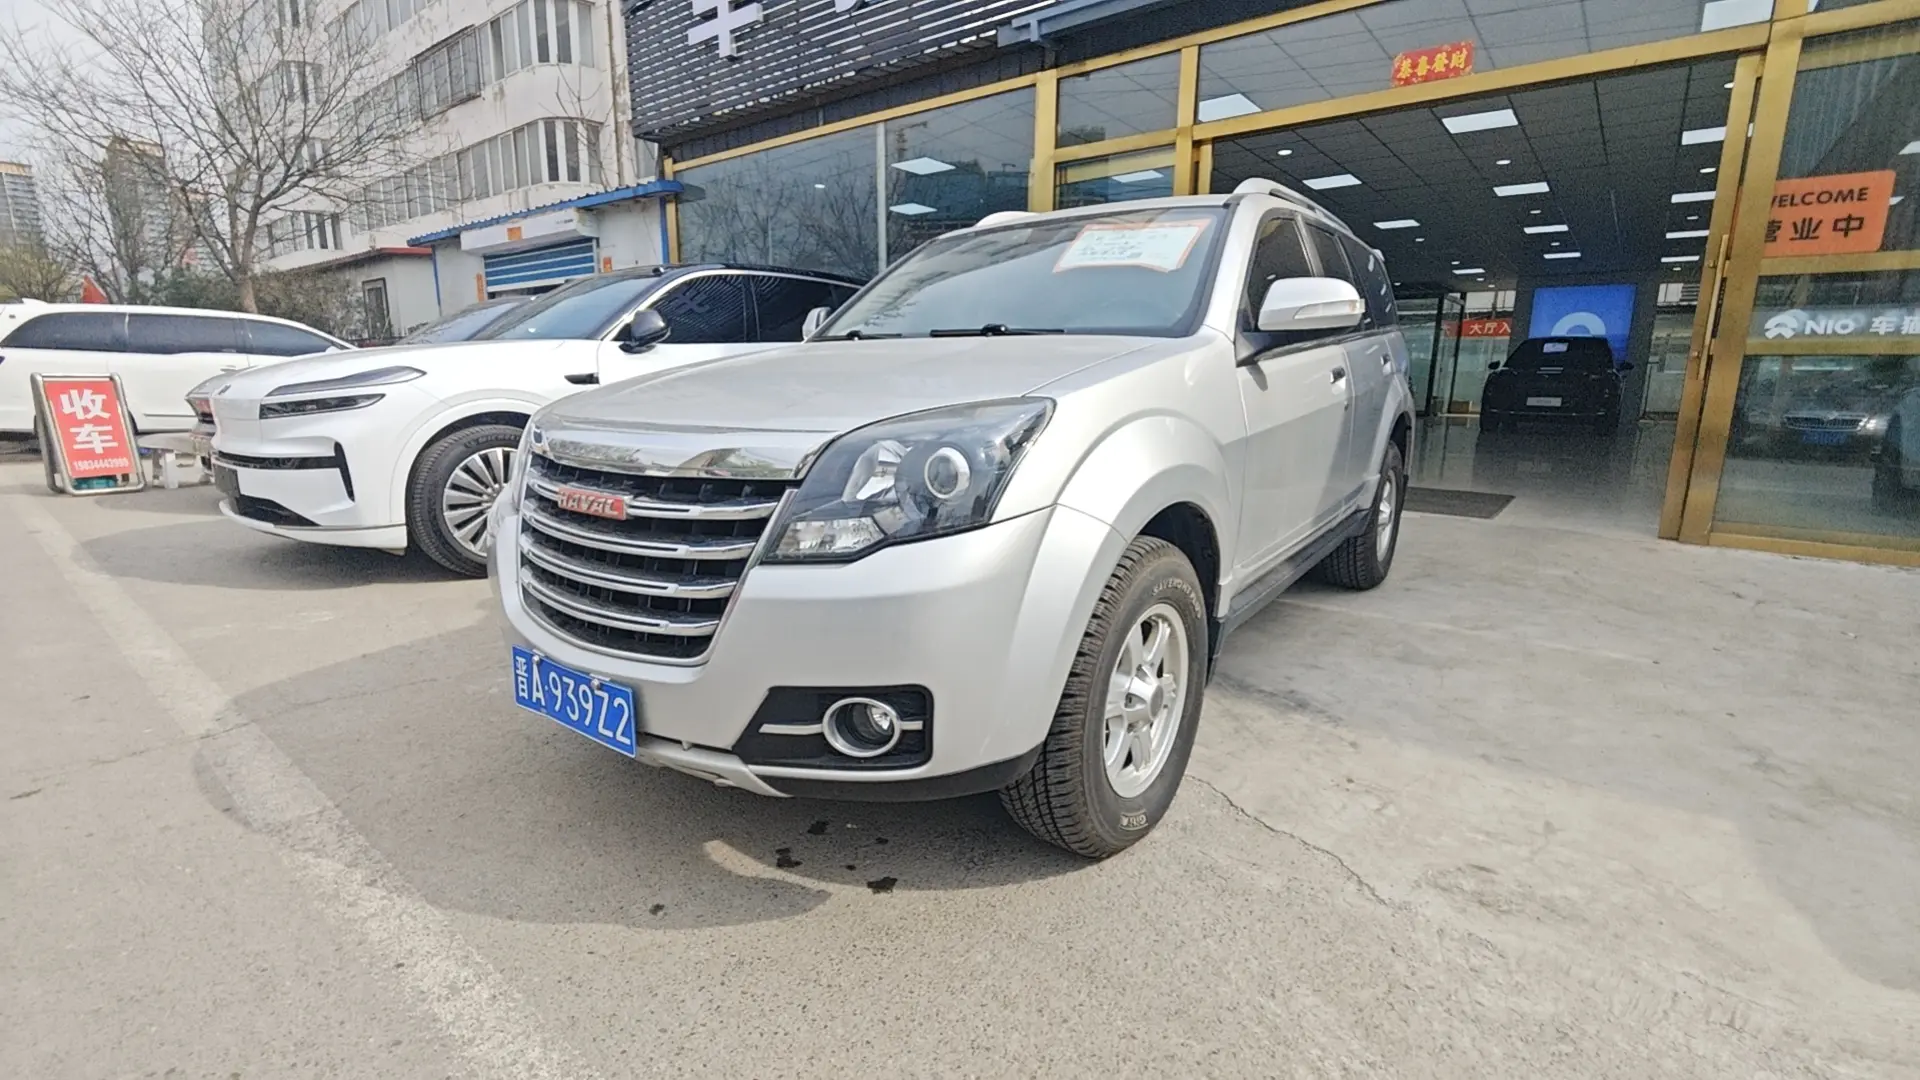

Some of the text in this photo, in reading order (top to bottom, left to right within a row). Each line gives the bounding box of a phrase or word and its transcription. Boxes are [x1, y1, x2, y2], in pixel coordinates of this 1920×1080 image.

[1804, 318, 1855, 335] NIO
[60, 388, 119, 454] 收车
[558, 490, 620, 516] HAVAL
